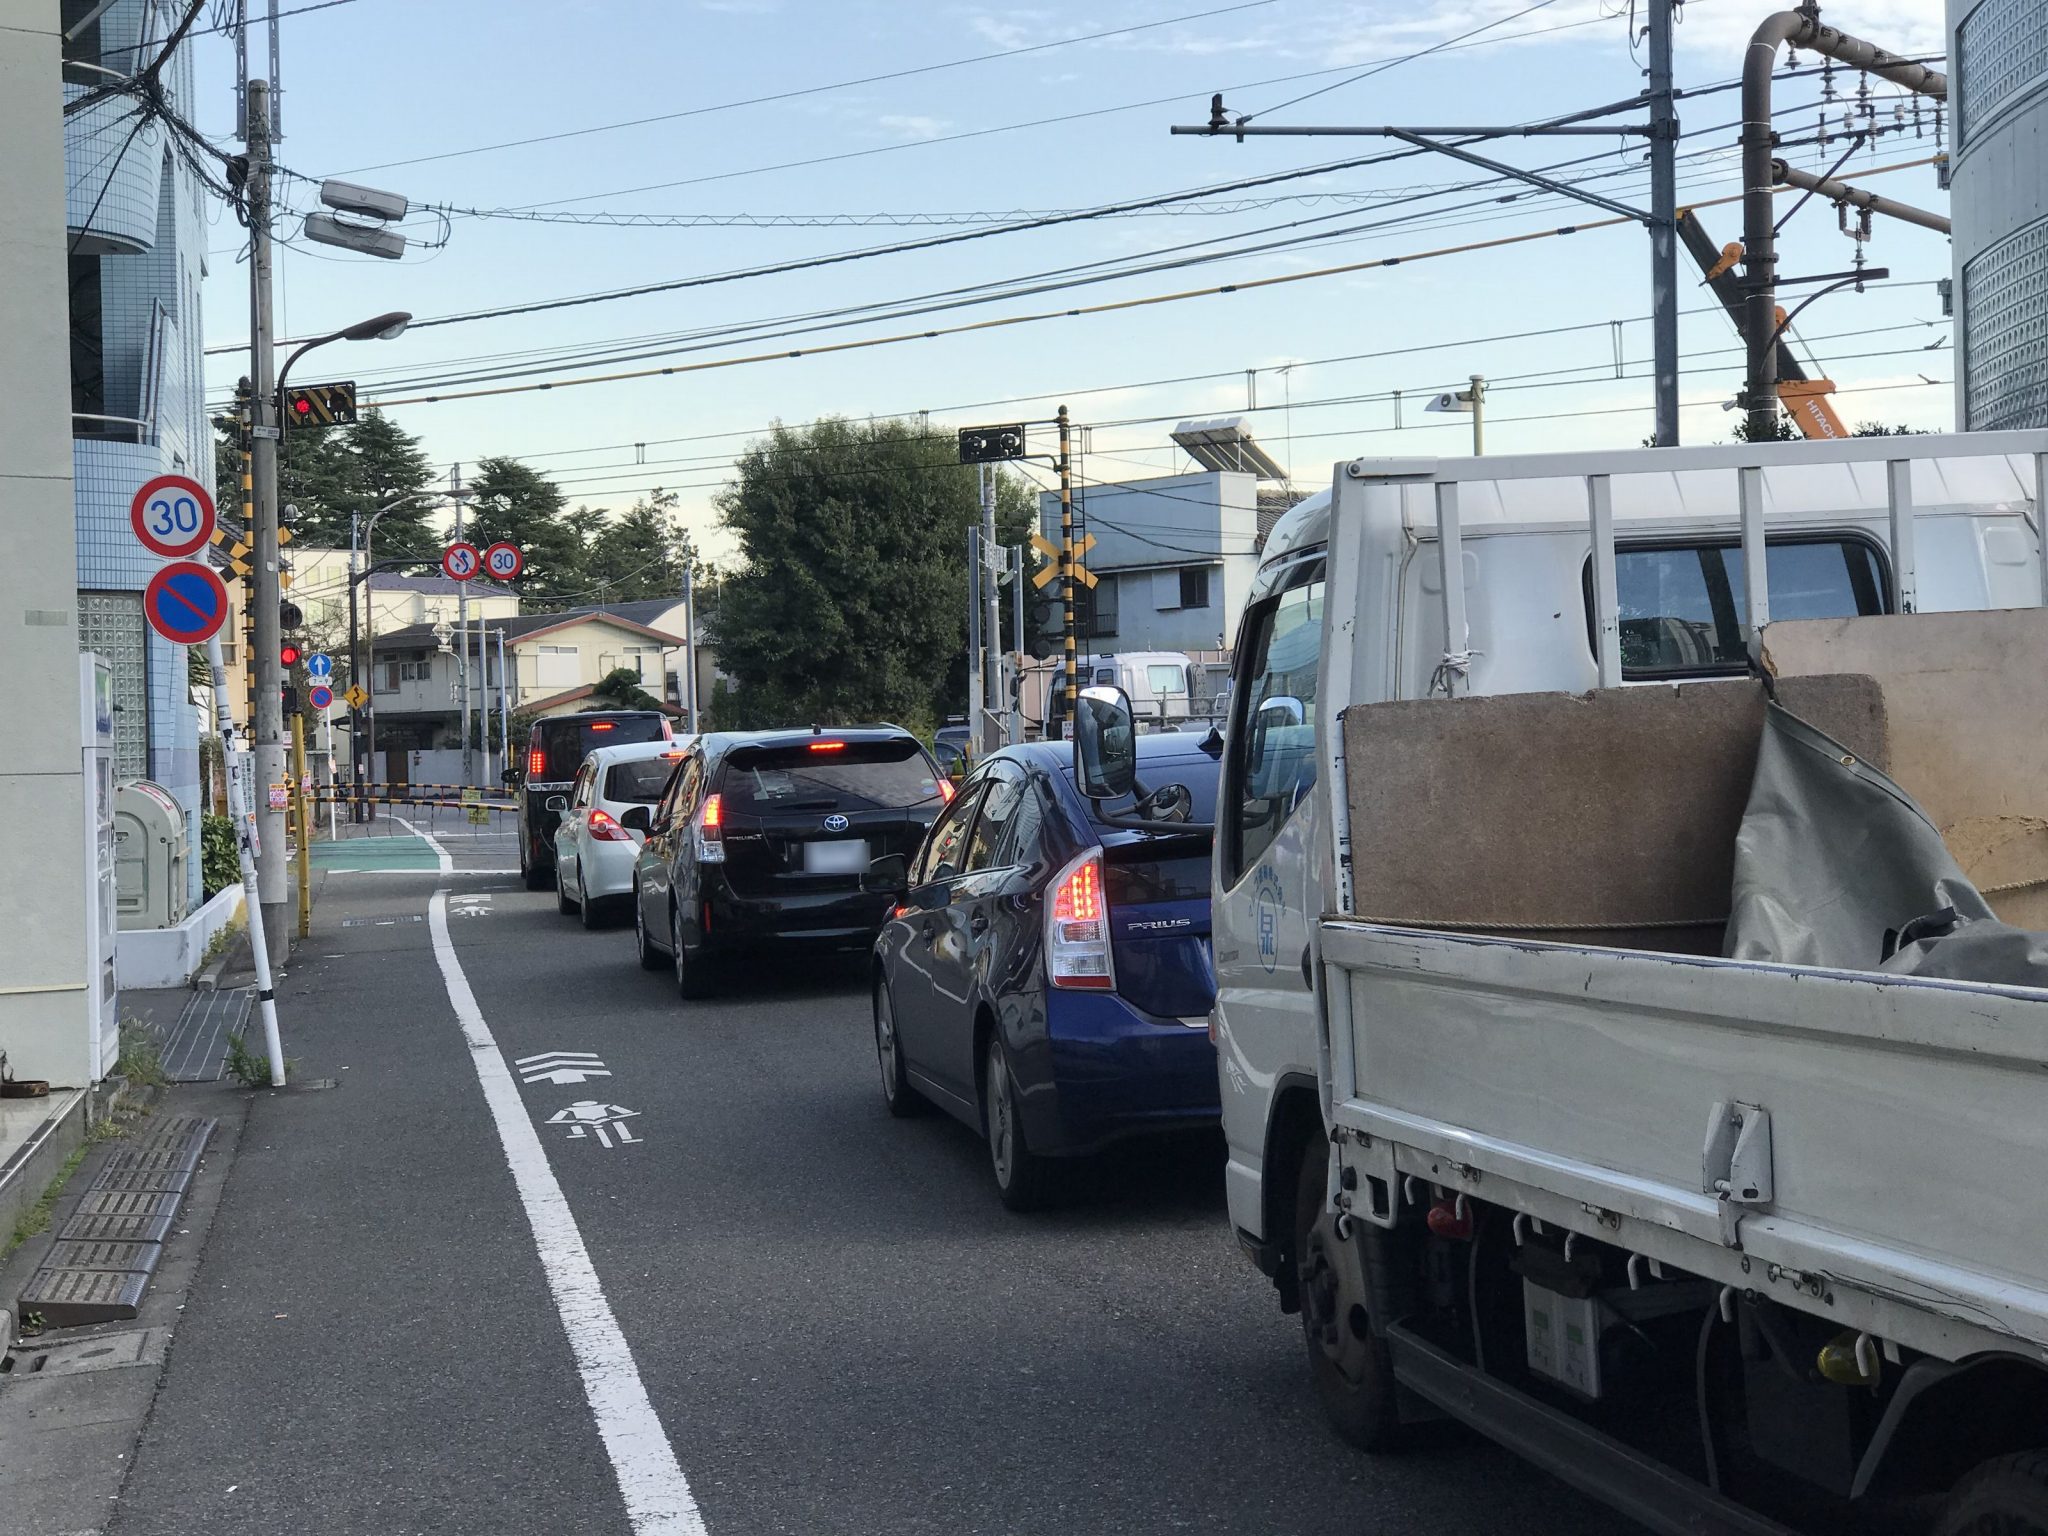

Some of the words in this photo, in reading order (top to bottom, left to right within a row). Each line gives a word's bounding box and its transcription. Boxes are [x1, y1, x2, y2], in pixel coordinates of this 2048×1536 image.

[1806, 400, 1837, 439] HITACH
[151, 498, 197, 535] 30
[493, 553, 514, 569] 30
[1127, 918, 1191, 931] PRIUS
